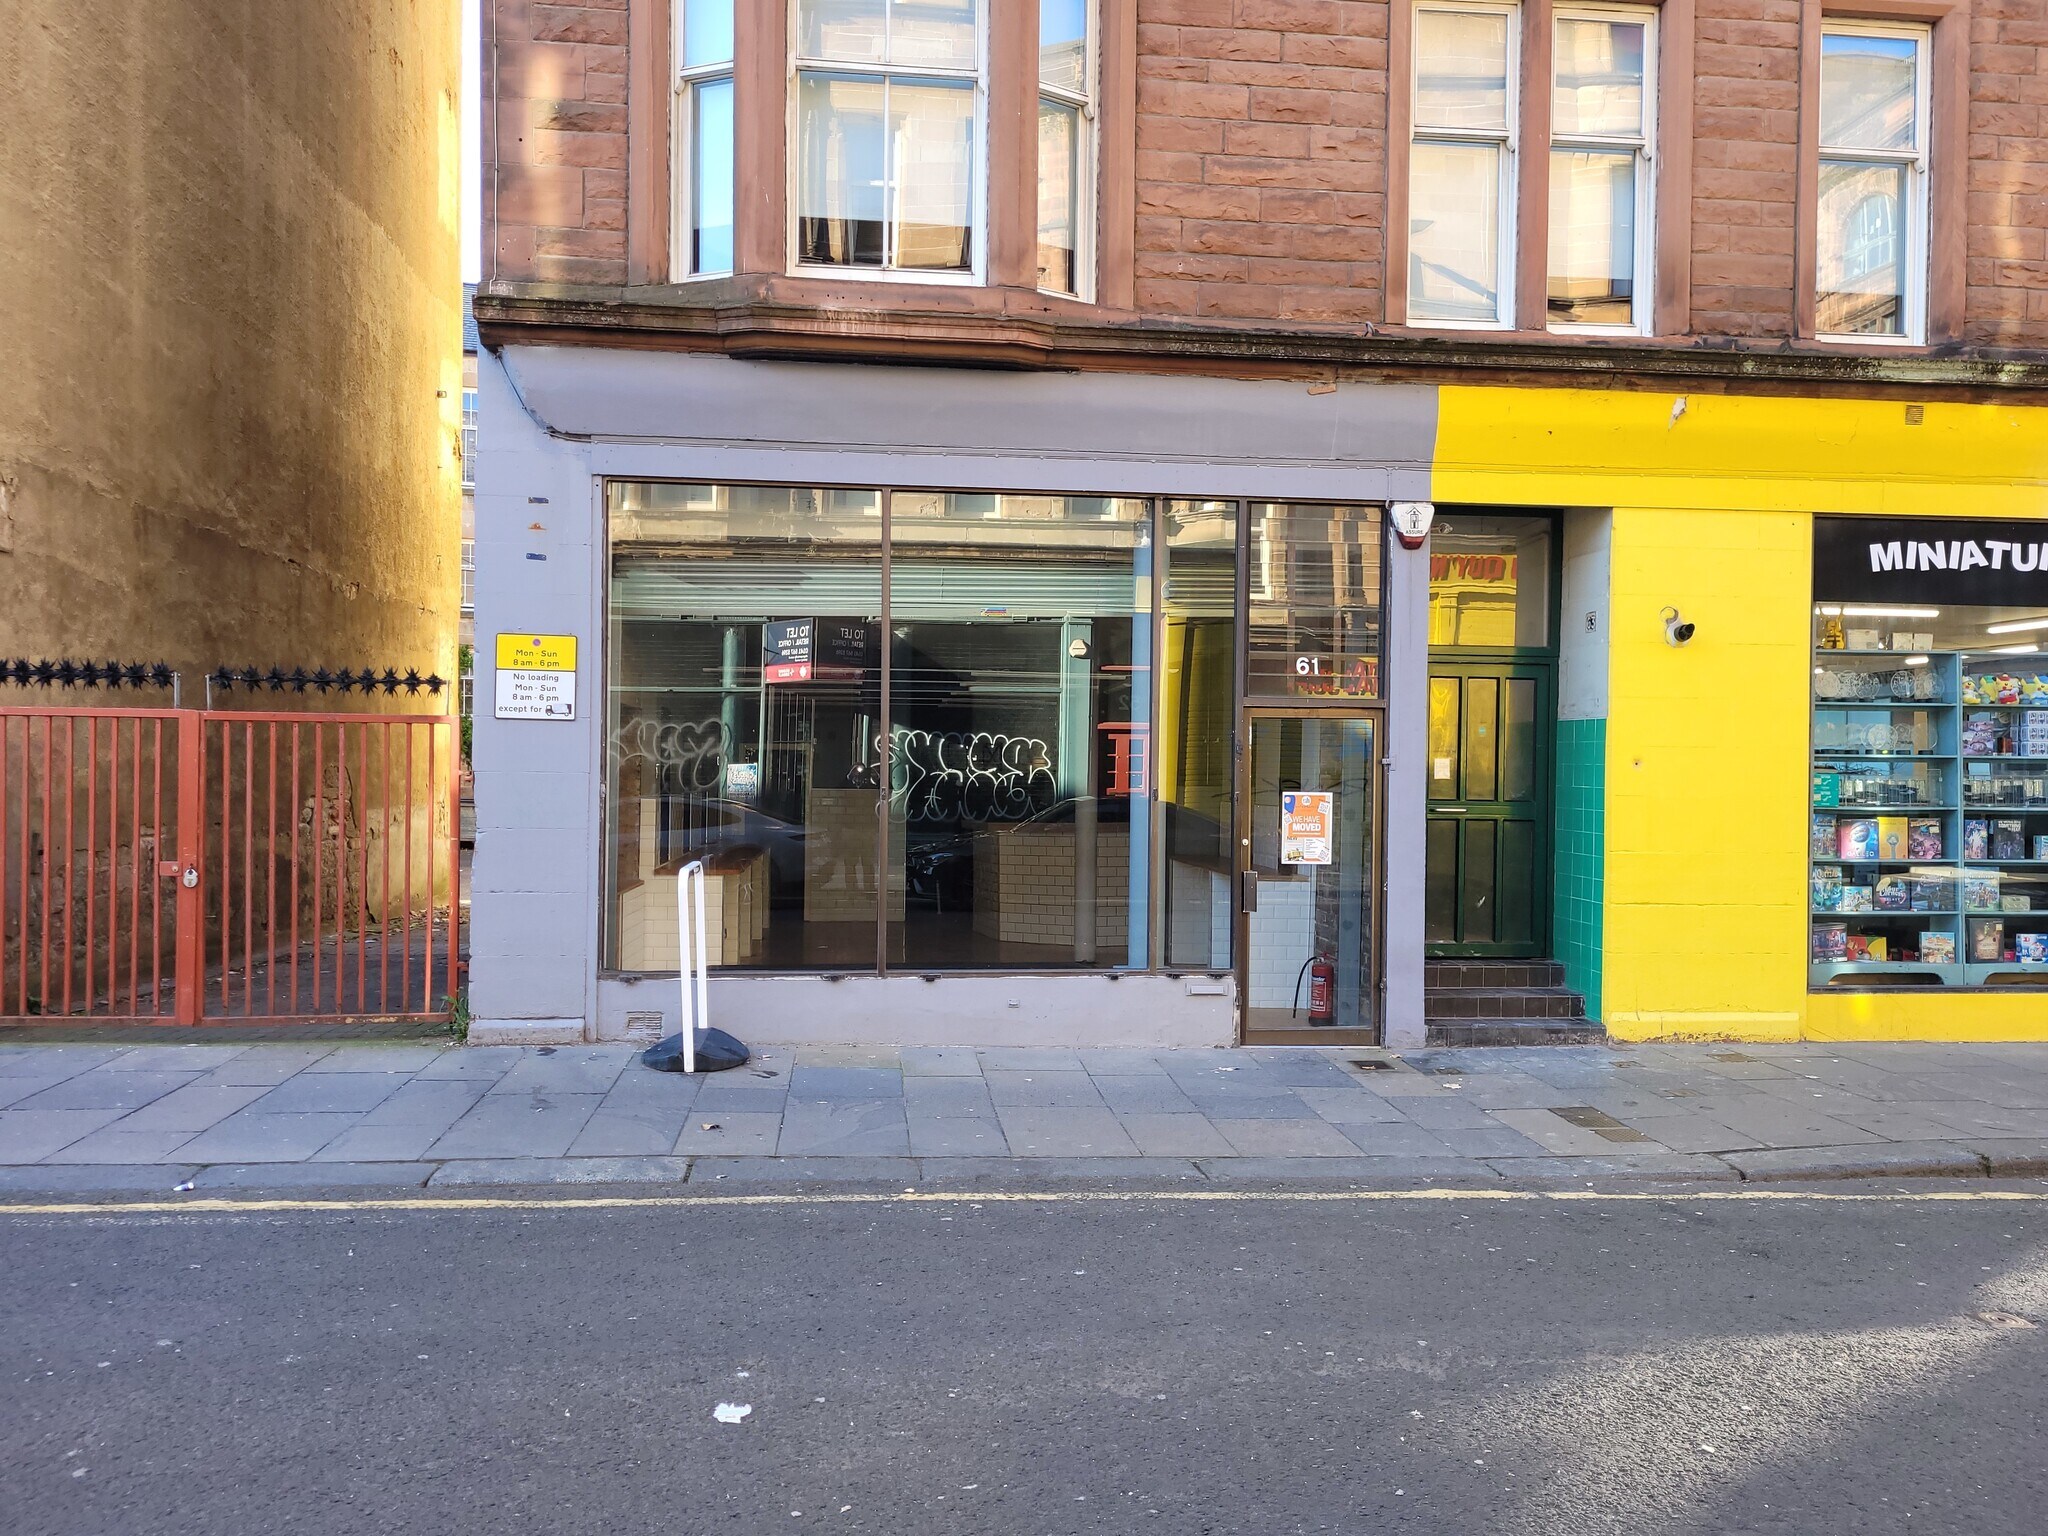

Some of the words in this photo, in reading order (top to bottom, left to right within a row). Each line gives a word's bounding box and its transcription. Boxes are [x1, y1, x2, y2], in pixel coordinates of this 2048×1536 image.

[1296, 657, 1319, 675] 61
[528, 674, 559, 682] loading
[498, 705, 528, 713] except
[1292, 823, 1321, 831] MOVED
